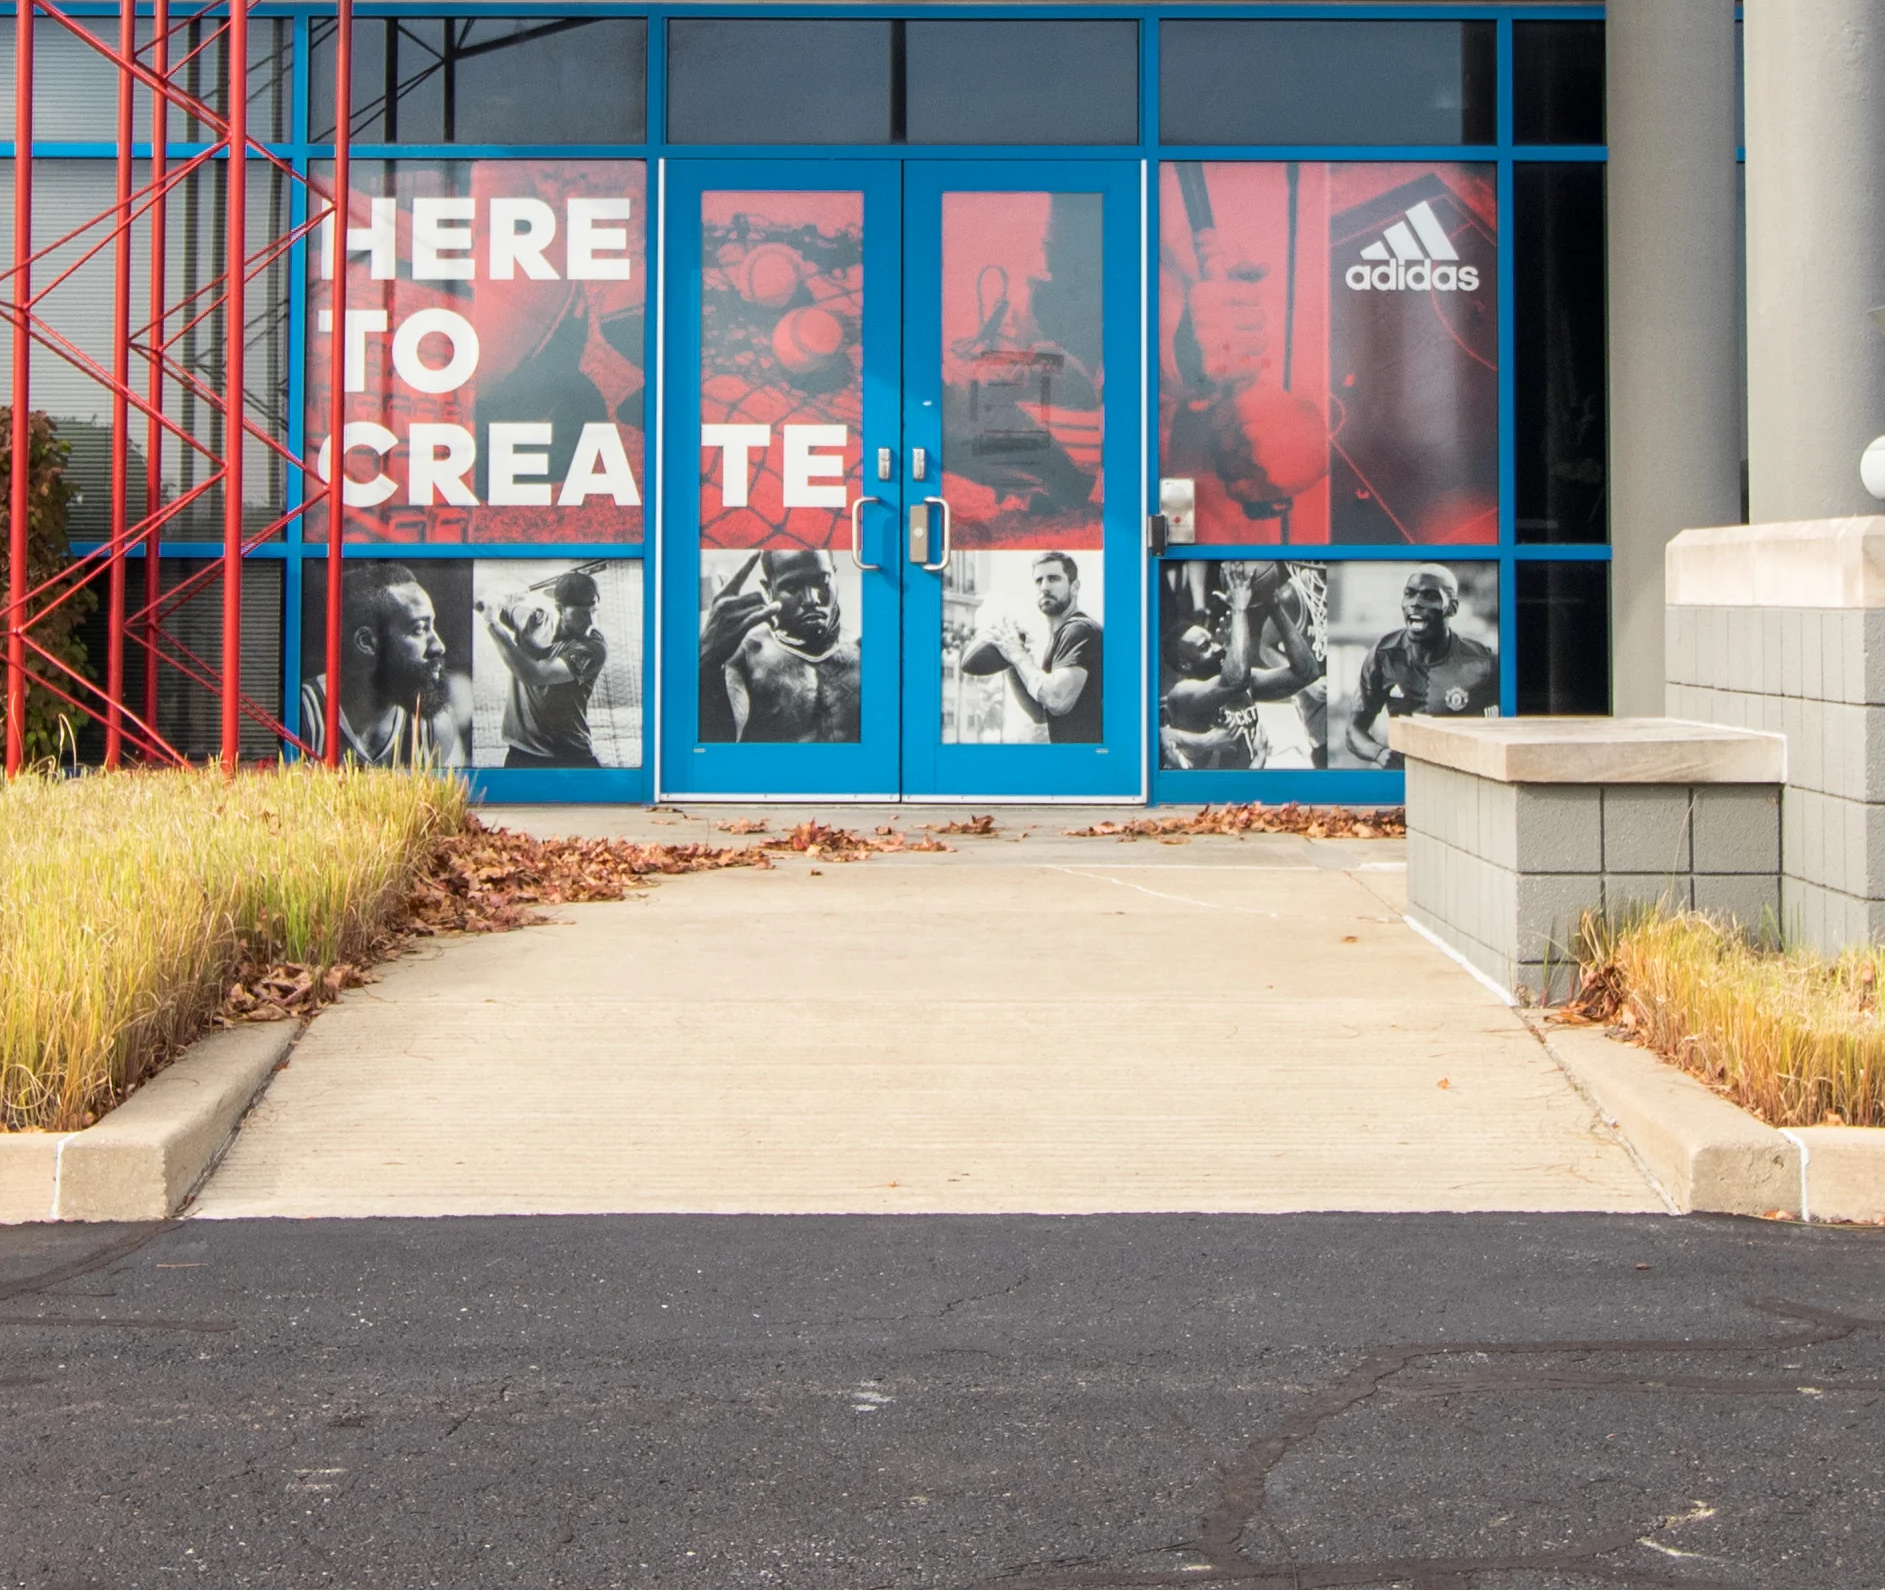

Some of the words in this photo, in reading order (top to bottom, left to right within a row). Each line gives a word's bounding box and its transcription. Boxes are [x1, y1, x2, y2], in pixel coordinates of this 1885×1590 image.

[319, 197, 631, 281] HERE
[1345, 258, 1480, 292] adidas
[319, 308, 480, 393] TO
